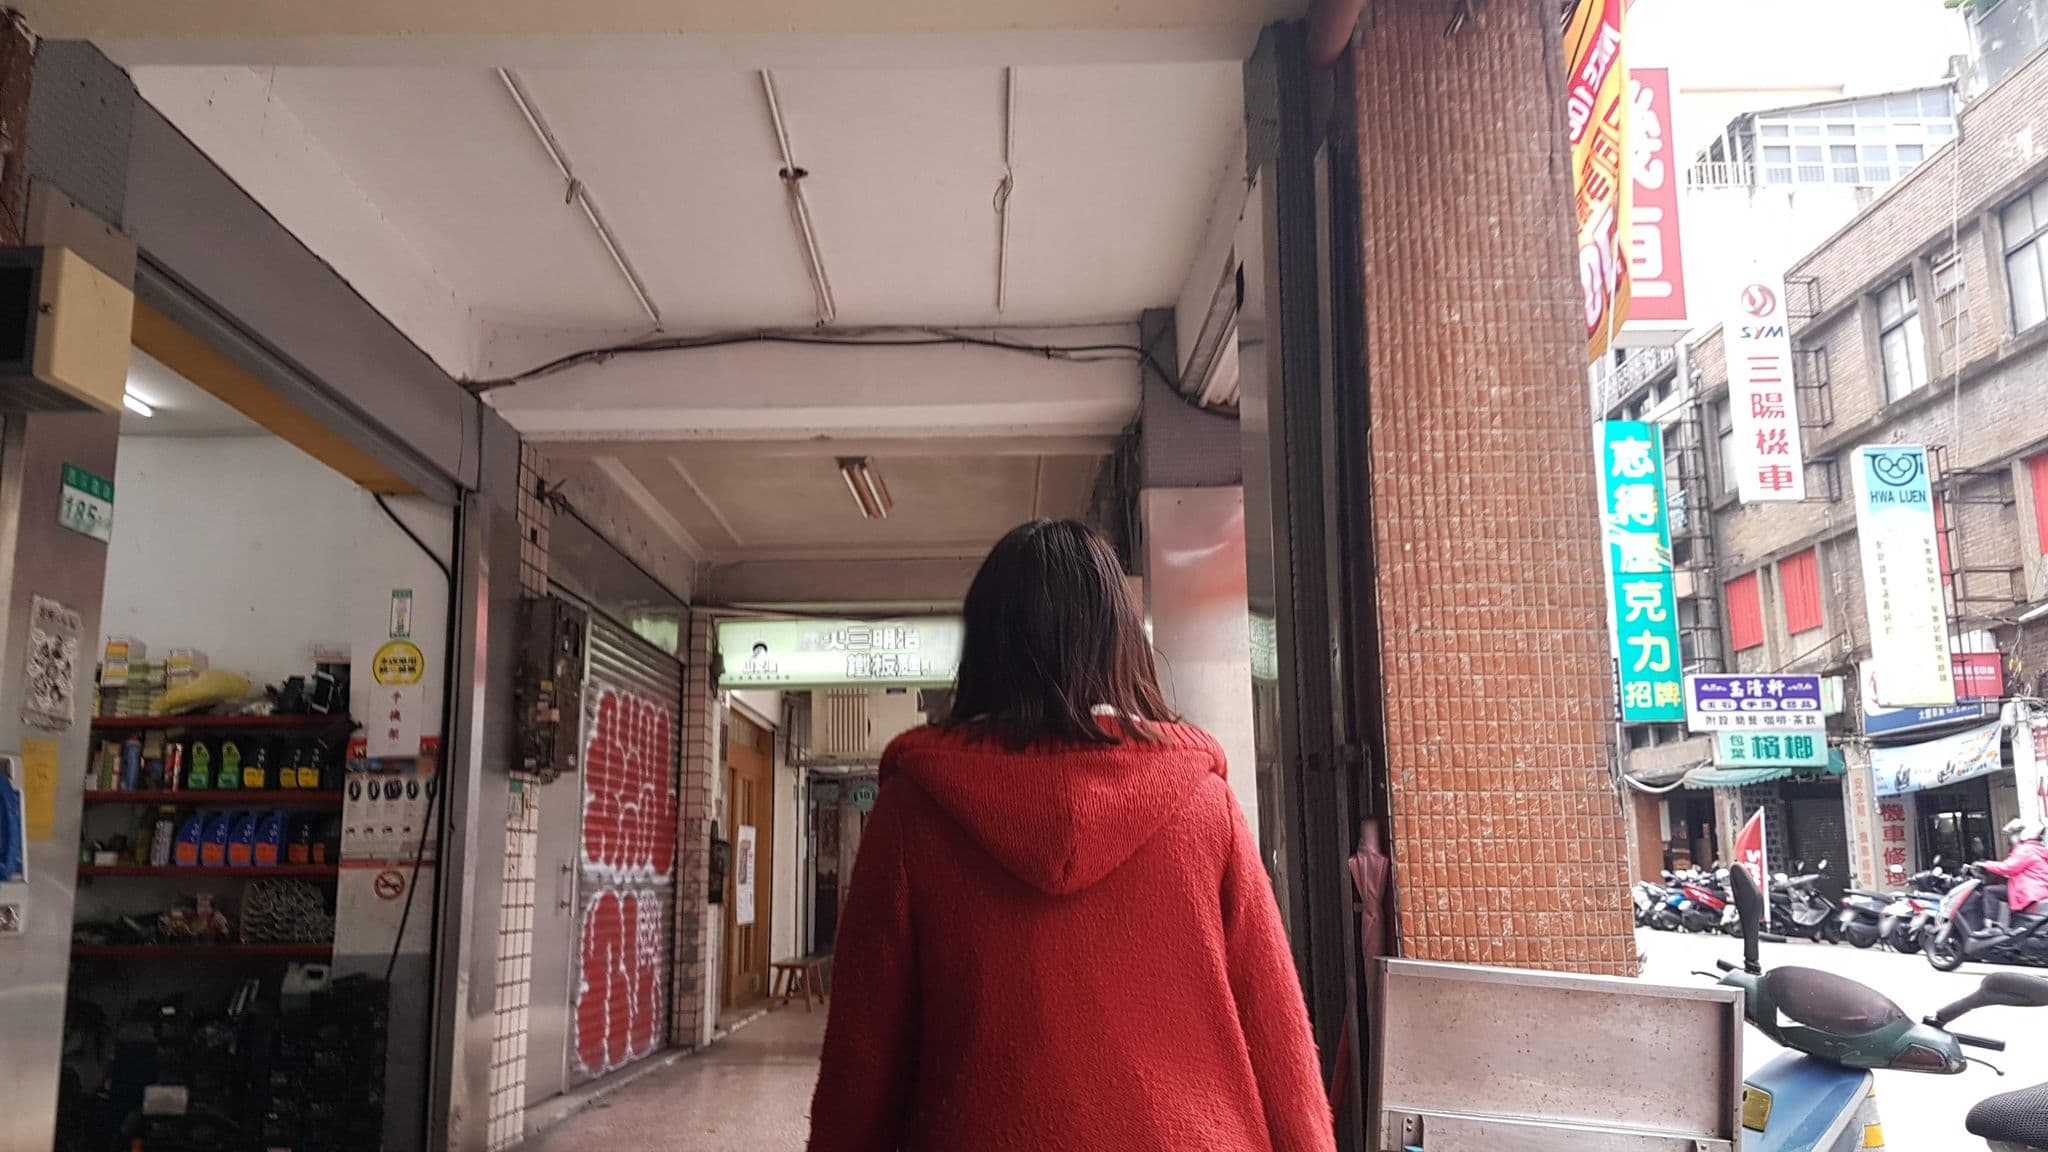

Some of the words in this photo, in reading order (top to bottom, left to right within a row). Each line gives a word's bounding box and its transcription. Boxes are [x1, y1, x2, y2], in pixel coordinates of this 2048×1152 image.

[1741, 325, 1784, 340] SYM
[1747, 355, 1794, 491] 三陽機車
[1870, 490, 1895, 504] HWA
[1899, 490, 1927, 503] LUEN
[1624, 680, 1682, 709] 招牌
[1751, 735, 1814, 760] 檳榔
